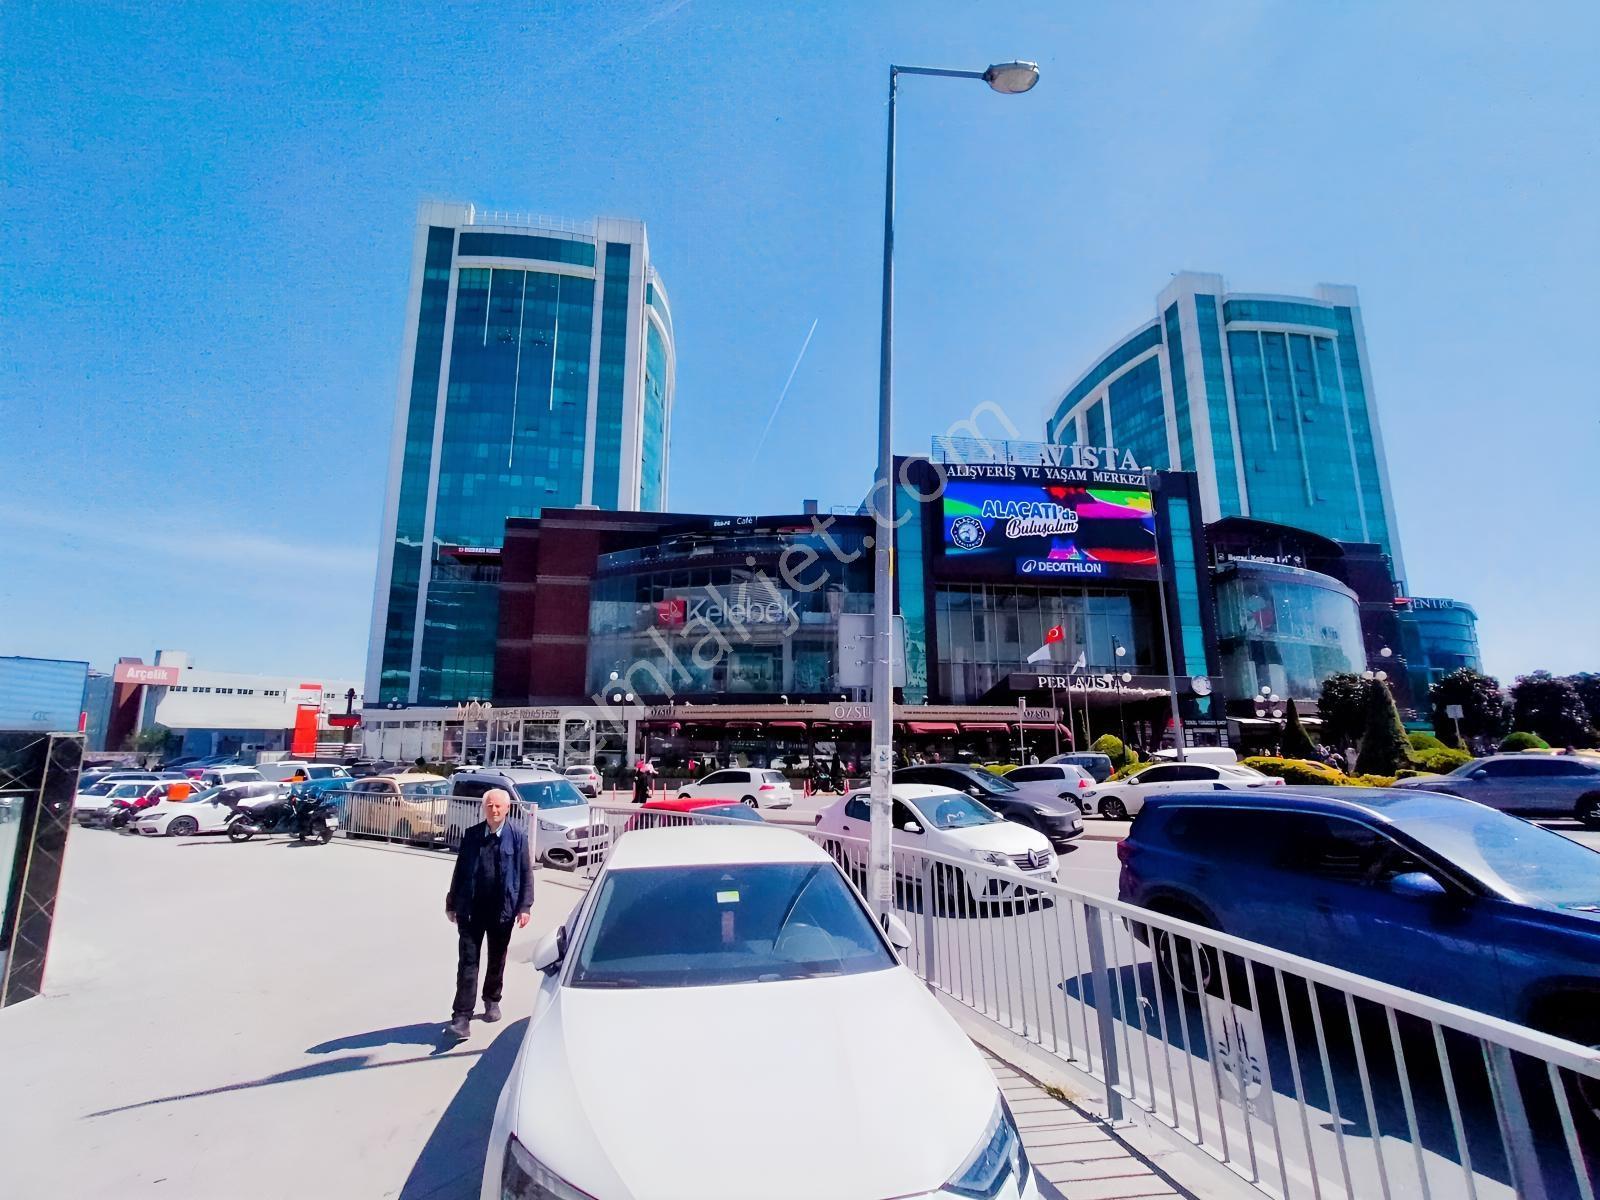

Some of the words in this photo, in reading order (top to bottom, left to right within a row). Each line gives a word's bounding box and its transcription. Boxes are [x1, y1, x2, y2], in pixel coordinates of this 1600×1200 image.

[947, 465, 1016, 480] ALIŞVERİŞ
[1022, 467, 1041, 479] VE
[1045, 468, 1088, 482] YAŞAM
[1038, 562, 1102, 573] DECATHLON
[686, 596, 800, 624] Kelebek
[127, 667, 168, 680] Arçelik
